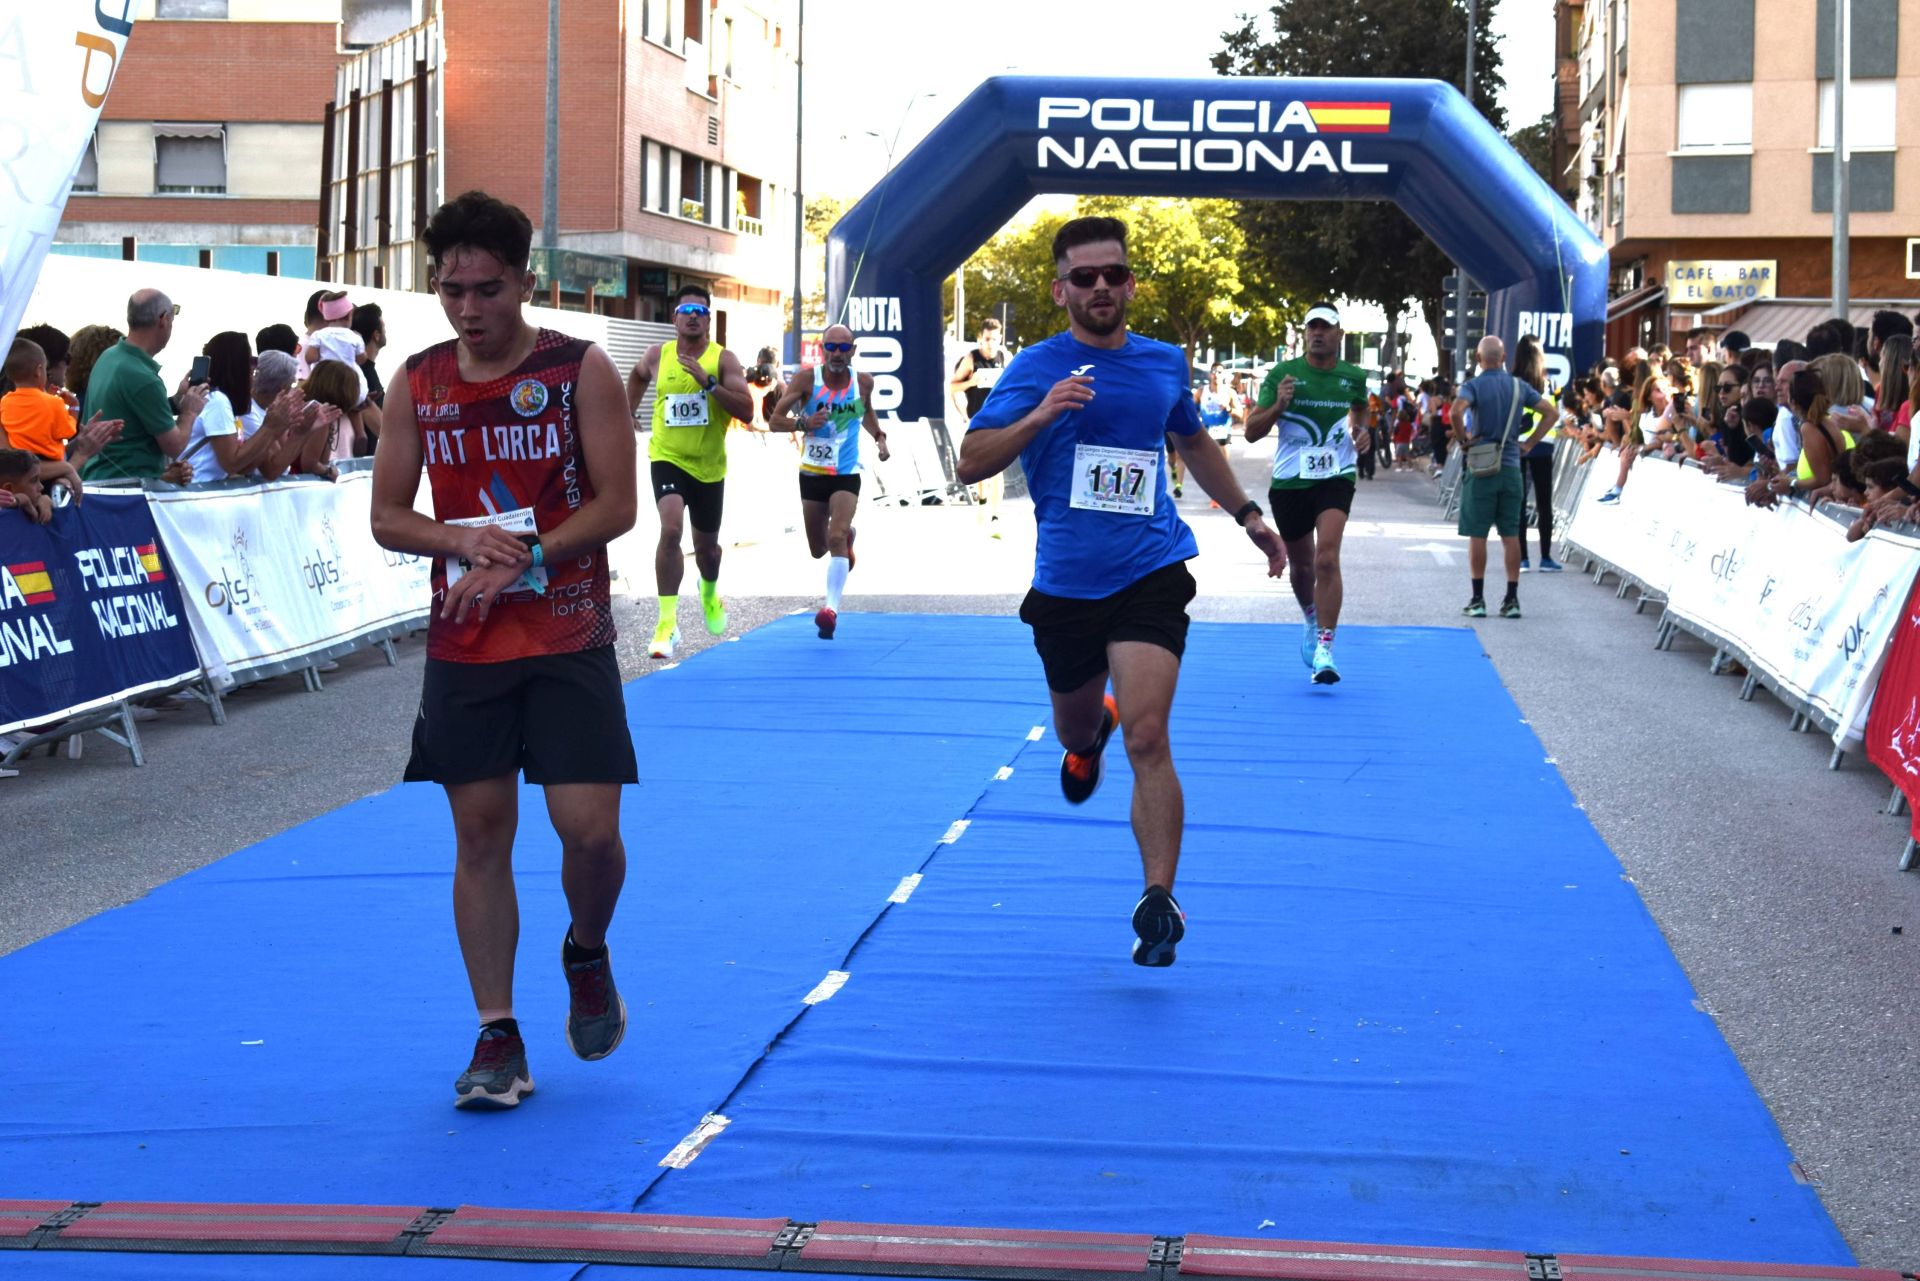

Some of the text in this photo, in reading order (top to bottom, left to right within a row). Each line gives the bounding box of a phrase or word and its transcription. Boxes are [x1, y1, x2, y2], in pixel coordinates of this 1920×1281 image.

[1038, 97, 1318, 133] POLICIA
[1038, 136, 1389, 173] NACIONAL
[1739, 267, 1770, 280] BAR
[1688, 285, 1757, 298] EL GATO
[848, 297, 902, 332] RUTA
[671, 403, 700, 417] 105
[423, 423, 561, 465] PAT LORCA
[808, 444, 833, 460] 252
[1307, 455, 1333, 470] 341
[1090, 464, 1144, 496] 117
[91, 591, 178, 640] NACIONAL
